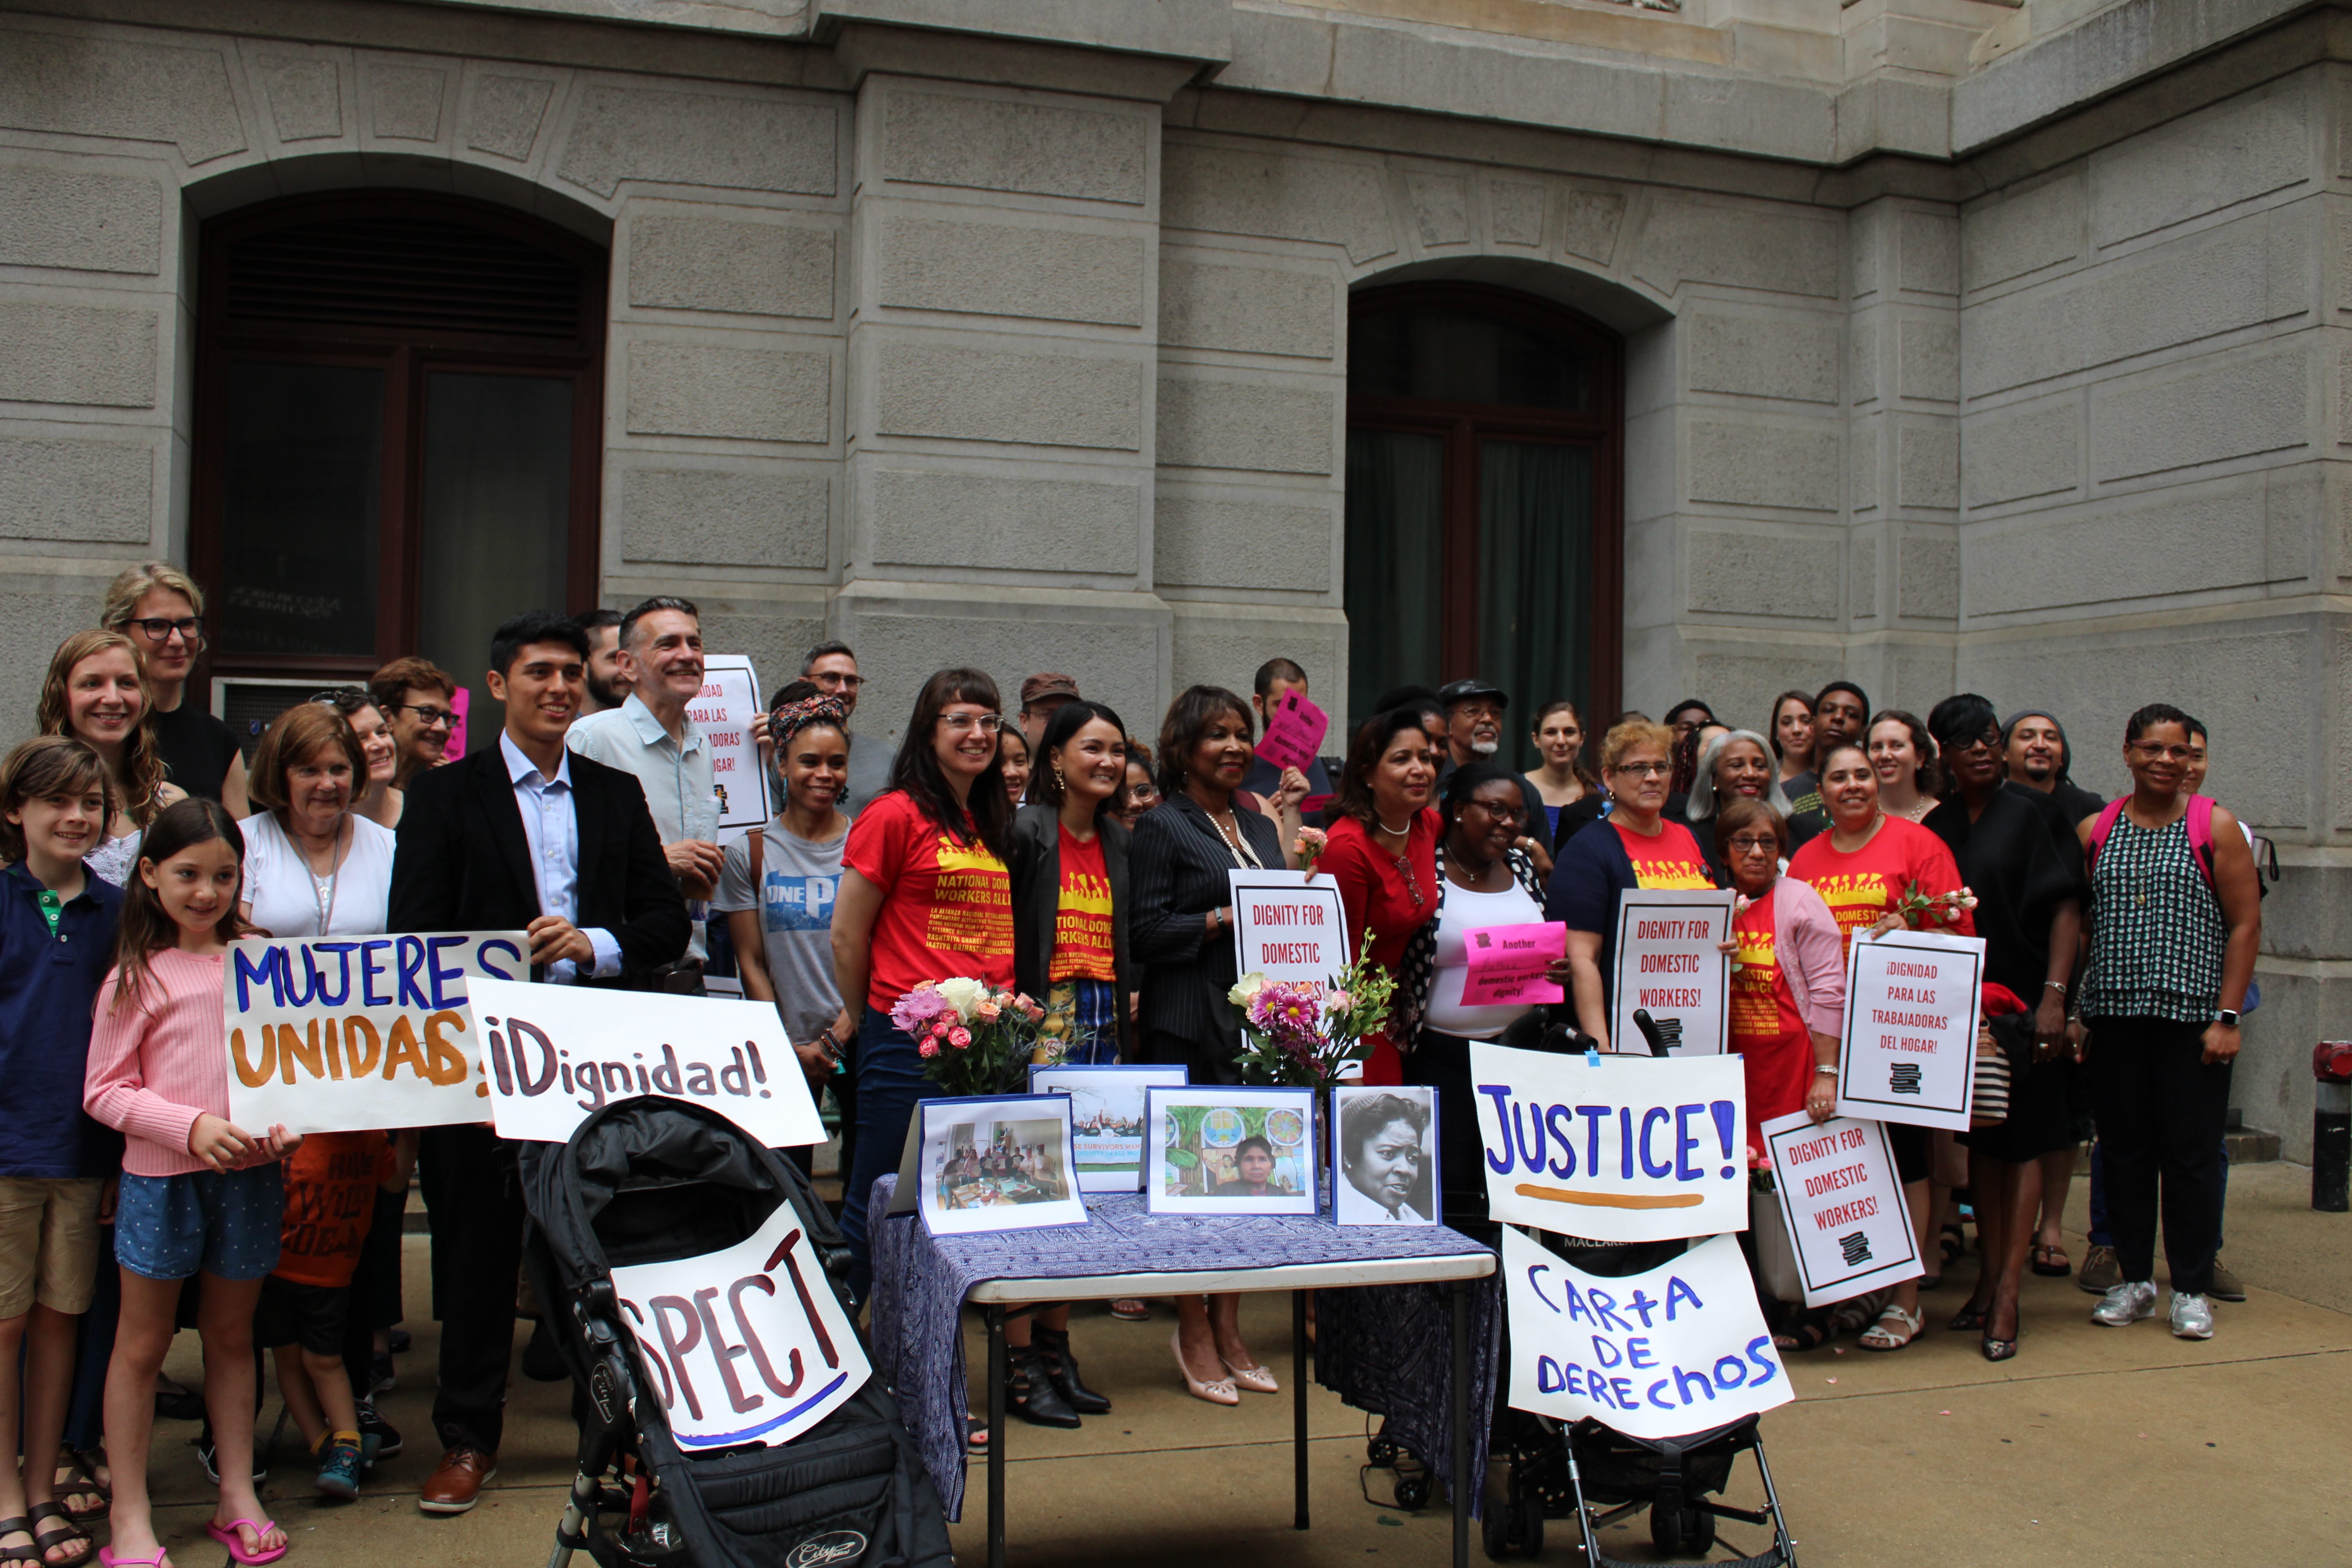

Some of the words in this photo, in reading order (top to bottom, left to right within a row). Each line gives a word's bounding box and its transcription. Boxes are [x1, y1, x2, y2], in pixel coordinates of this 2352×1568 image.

[693, 684, 723, 698] NIDAD
[711, 708, 728, 722] LAS
[937, 875, 989, 888] NATIONAL
[766, 885, 805, 904] ONE
[935, 889, 991, 904] WORKERS
[962, 910, 984, 918] NACIONAL
[1253, 905, 1298, 926] DIGNITY
[1302, 905, 1324, 926] FOR
[927, 926, 955, 935] L'ALLIANCE
[1056, 916, 1087, 931] TIONAL
[1638, 920, 1685, 939] DIGNITY
[1688, 920, 1710, 939] FOR
[926, 942, 950, 951] JAATIYO
[927, 933, 959, 943] RASHTRIYA
[1503, 939, 1536, 949] Another
[1262, 943, 1320, 964] DOMESTIC
[1641, 954, 1700, 973] DOMESTIC
[1887, 961, 1937, 979] ¡DIGNIDAD
[1478, 975, 1515, 986] domestic
[1517, 972, 1543, 982] worker
[1493, 985, 1524, 998] dignity!
[1640, 988, 1701, 1007] WORKERS!
[1888, 986, 1914, 1002] PARA
[1917, 989, 1935, 1004] LAS
[1872, 1009, 1948, 1030] TRABAJADORAS
[1880, 1035, 1897, 1050] DEL
[1901, 1037, 1938, 1054] HOGAR!
[1477, 1085, 1735, 1181] JUSTICE!
[1789, 1134, 1838, 1166] DIGNITY
[1840, 1128, 1866, 1151] FOR
[1805, 1163, 1867, 1198] DOMESTIC
[1813, 1196, 1880, 1231] WORKERS!
[1592, 1335, 1659, 1369] DE
